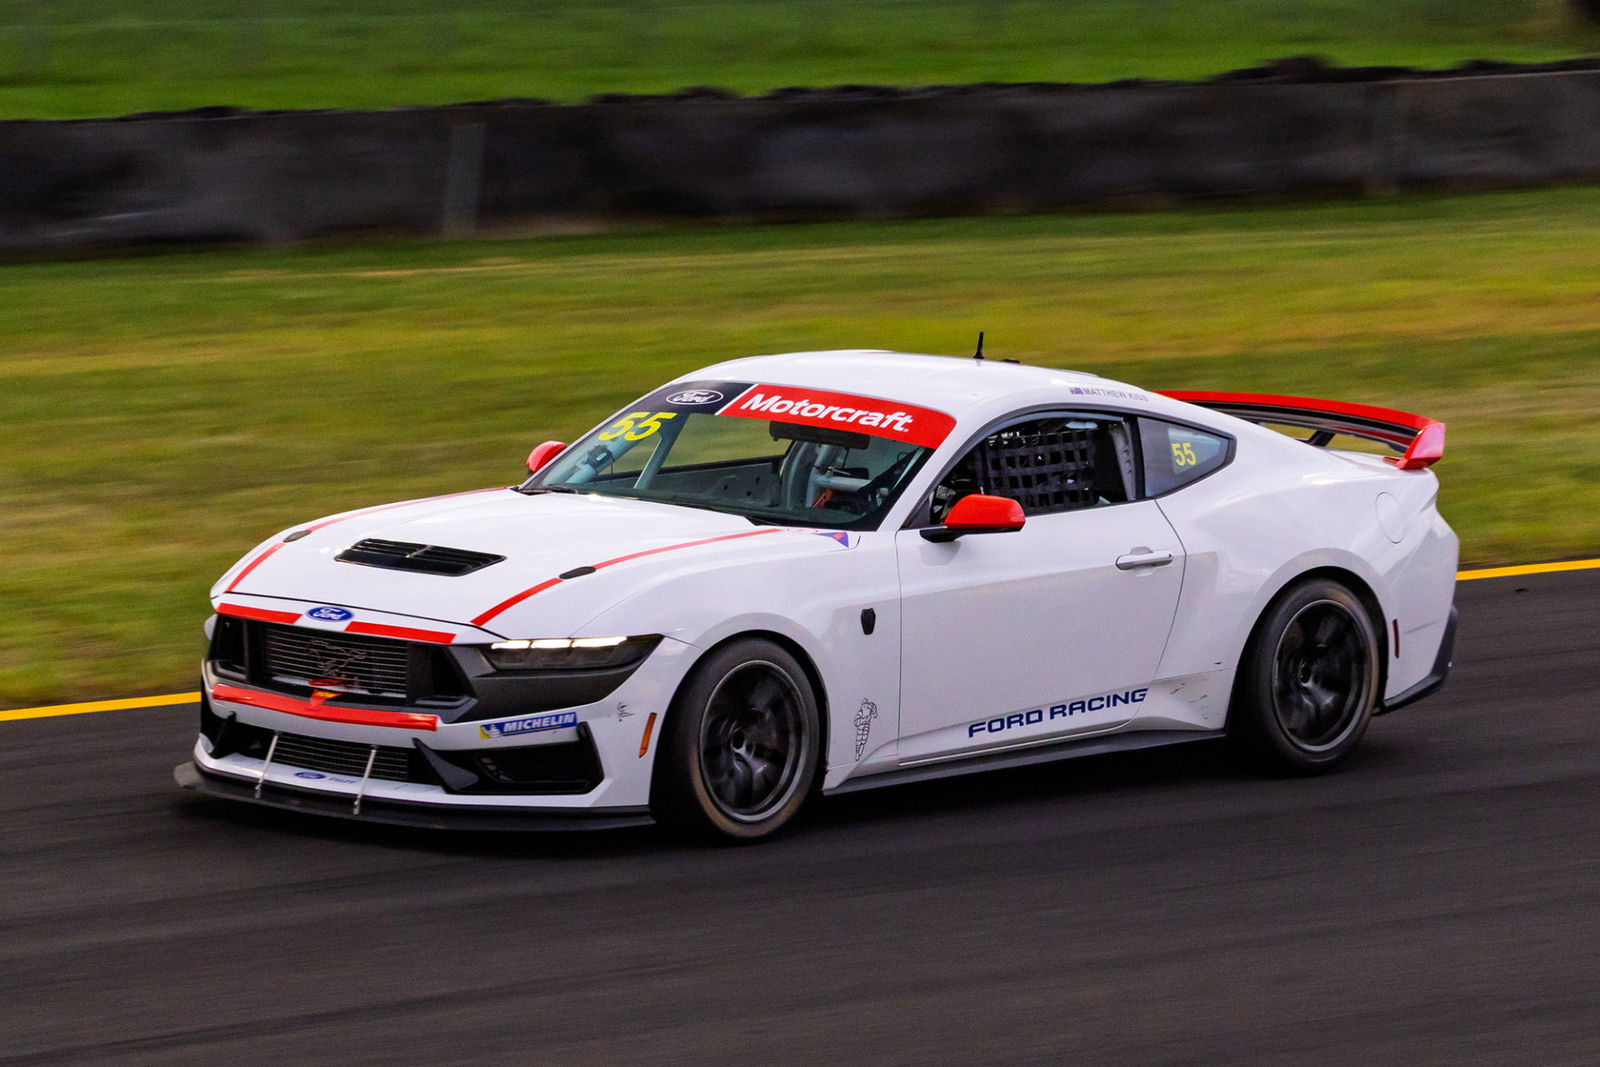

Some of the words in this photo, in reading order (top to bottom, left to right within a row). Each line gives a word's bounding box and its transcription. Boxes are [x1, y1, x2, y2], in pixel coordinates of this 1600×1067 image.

[671, 391, 716, 403] Ford
[739, 393, 913, 432] Motorcraft
[598, 411, 678, 441] 55
[1171, 442, 1196, 466] 55
[312, 607, 349, 620] Ford
[503, 713, 575, 733] MICHELIN
[968, 709, 1043, 738] FORD
[1049, 688, 1148, 720] RACING
